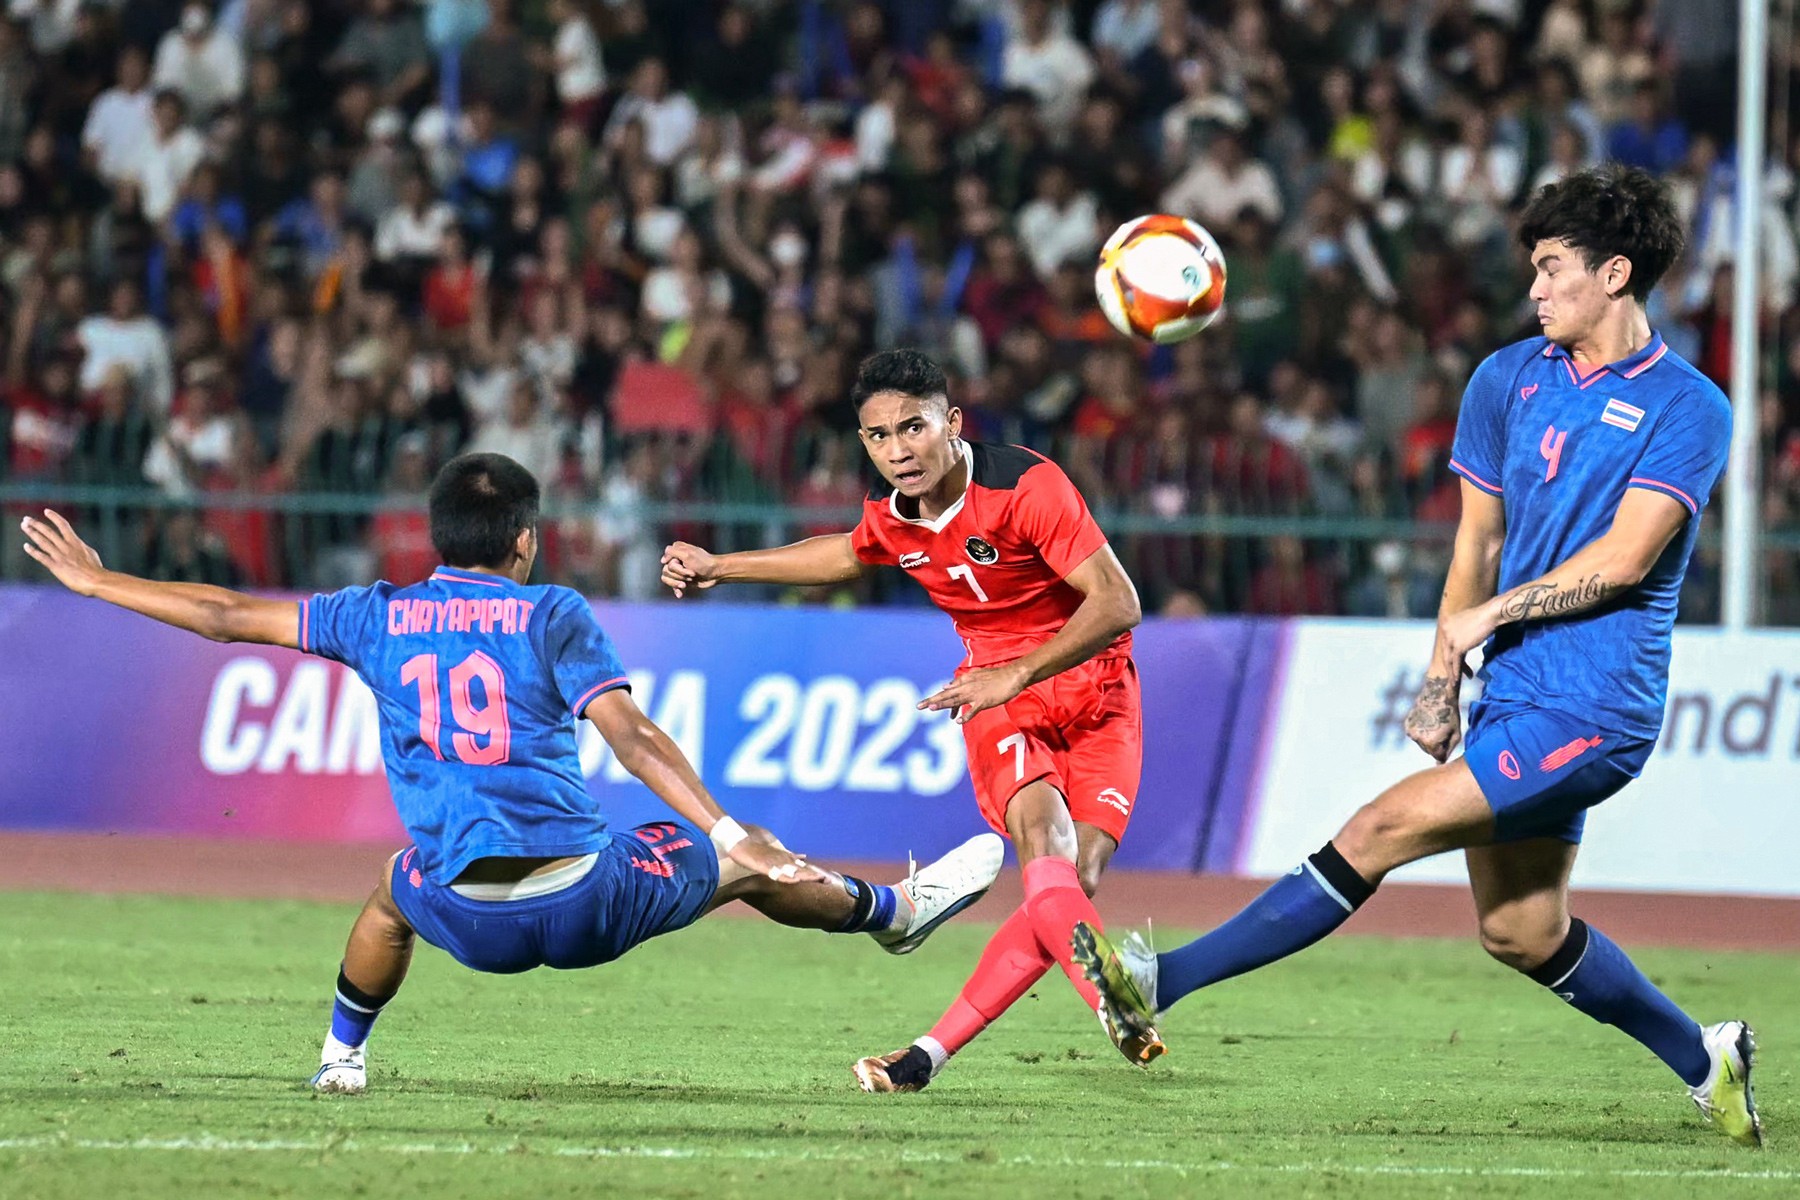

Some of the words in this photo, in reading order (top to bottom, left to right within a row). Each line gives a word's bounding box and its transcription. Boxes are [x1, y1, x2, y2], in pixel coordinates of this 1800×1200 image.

[1540, 425, 1568, 483] 4
[946, 563, 989, 603] 7
[387, 597, 534, 636] CHAYAPIPAT
[400, 649, 511, 766] 19
[723, 673, 968, 797] 2023
[996, 731, 1026, 782] 7
